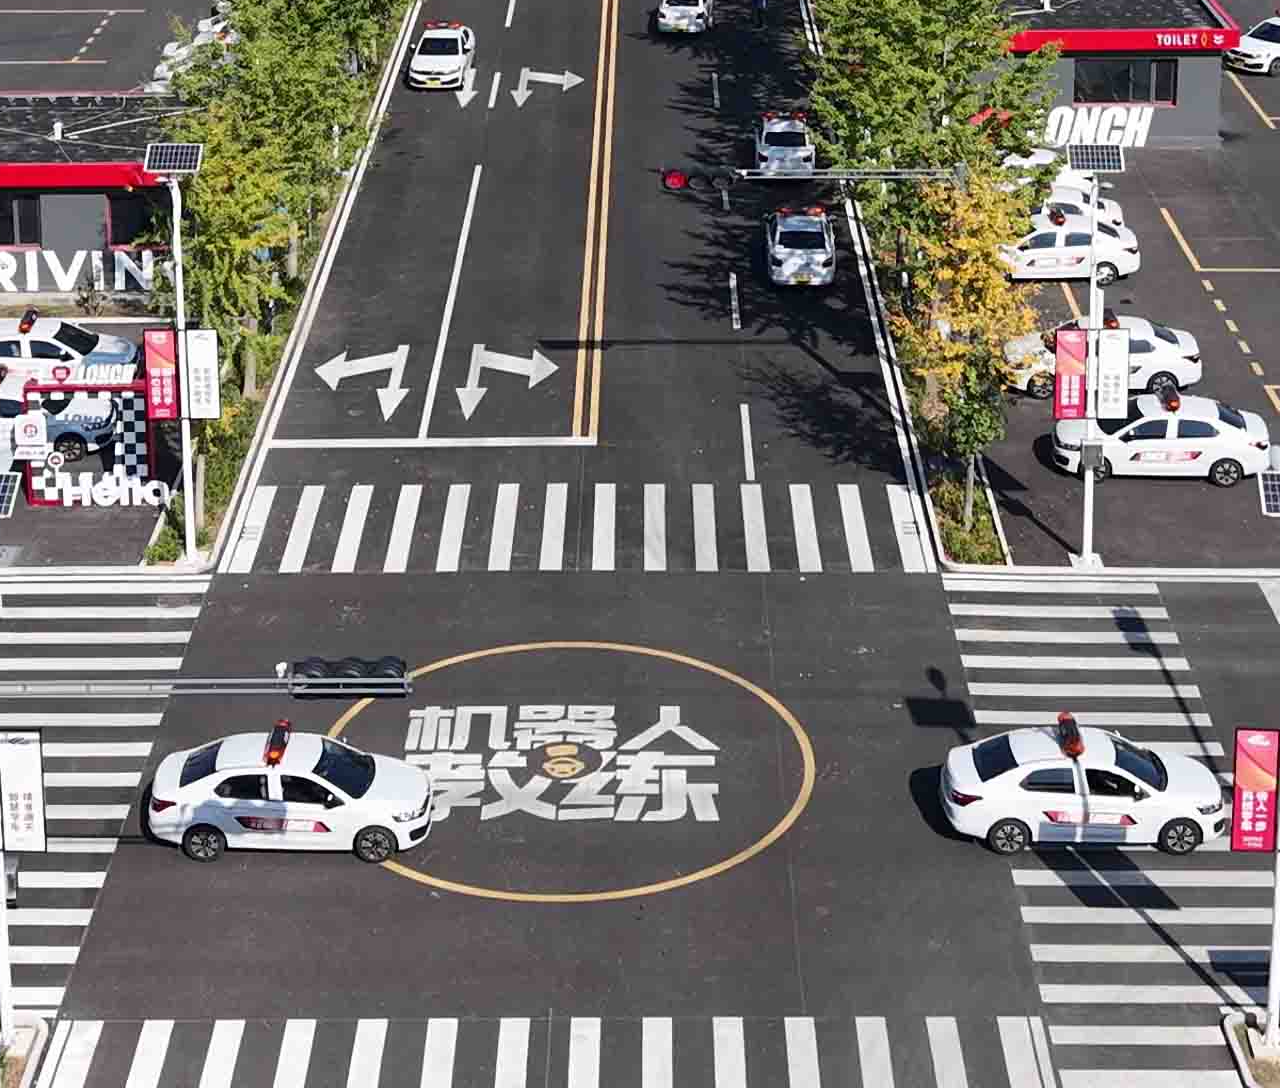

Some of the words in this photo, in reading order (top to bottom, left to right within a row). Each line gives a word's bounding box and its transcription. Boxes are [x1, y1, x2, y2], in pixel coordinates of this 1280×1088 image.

[1156, 33, 1198, 46] TOILET
[1030, 106, 1155, 147] ONCH
[404, 704, 721, 751] 机器人
[404, 750, 721, 822] 教练
